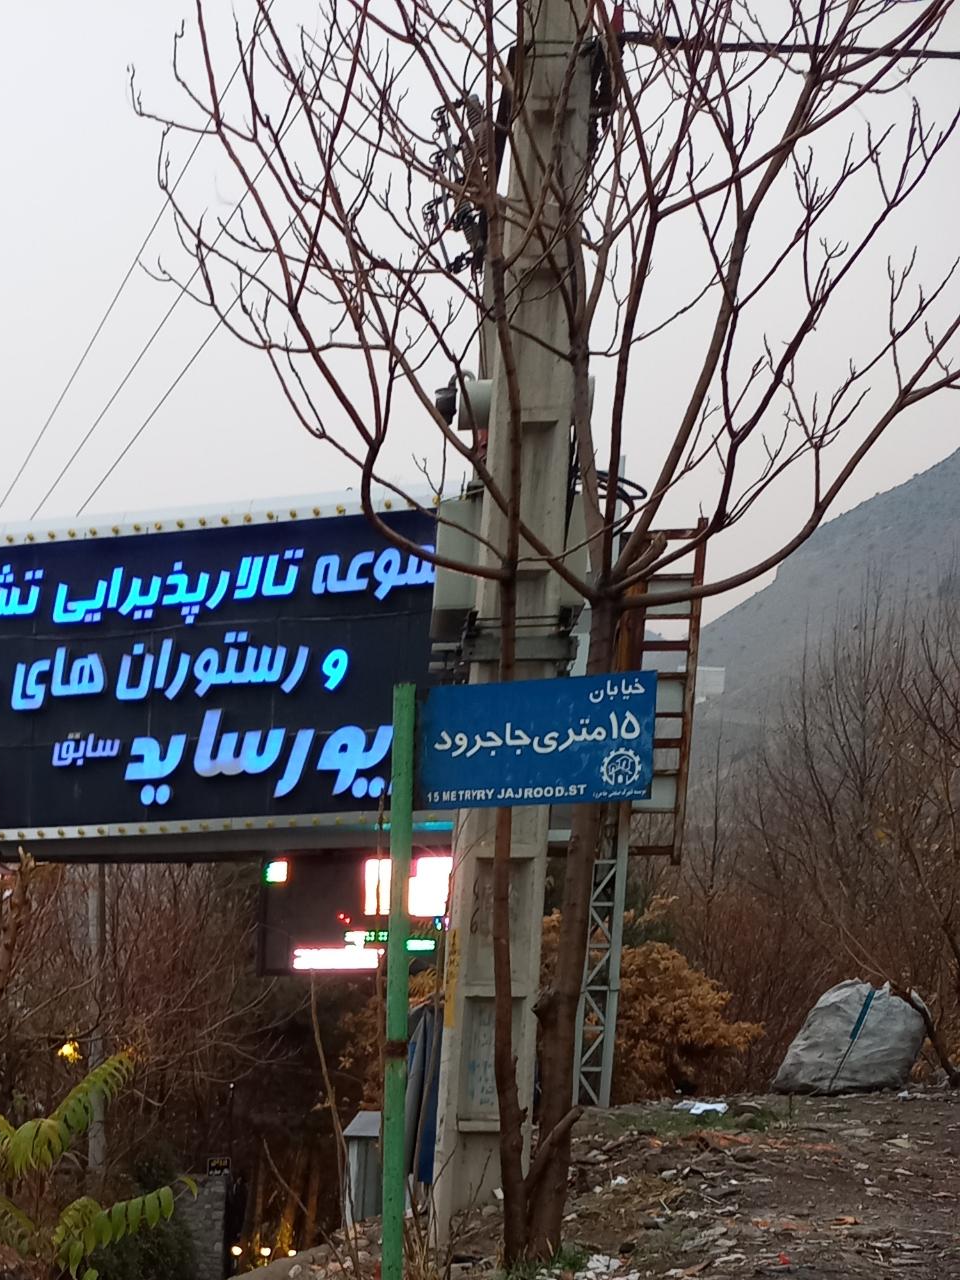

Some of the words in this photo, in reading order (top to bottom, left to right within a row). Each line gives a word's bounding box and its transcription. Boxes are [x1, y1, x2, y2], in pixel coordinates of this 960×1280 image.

[52, 560, 211, 625] پذیرایی
[11, 647, 104, 710] های
[115, 631, 309, 700] رستوران
[321, 648, 349, 691] و
[588, 679, 646, 704] خیابان
[52, 733, 120, 767] سابق
[124, 709, 394, 806] یورساید
[427, 791, 440, 803] 15
